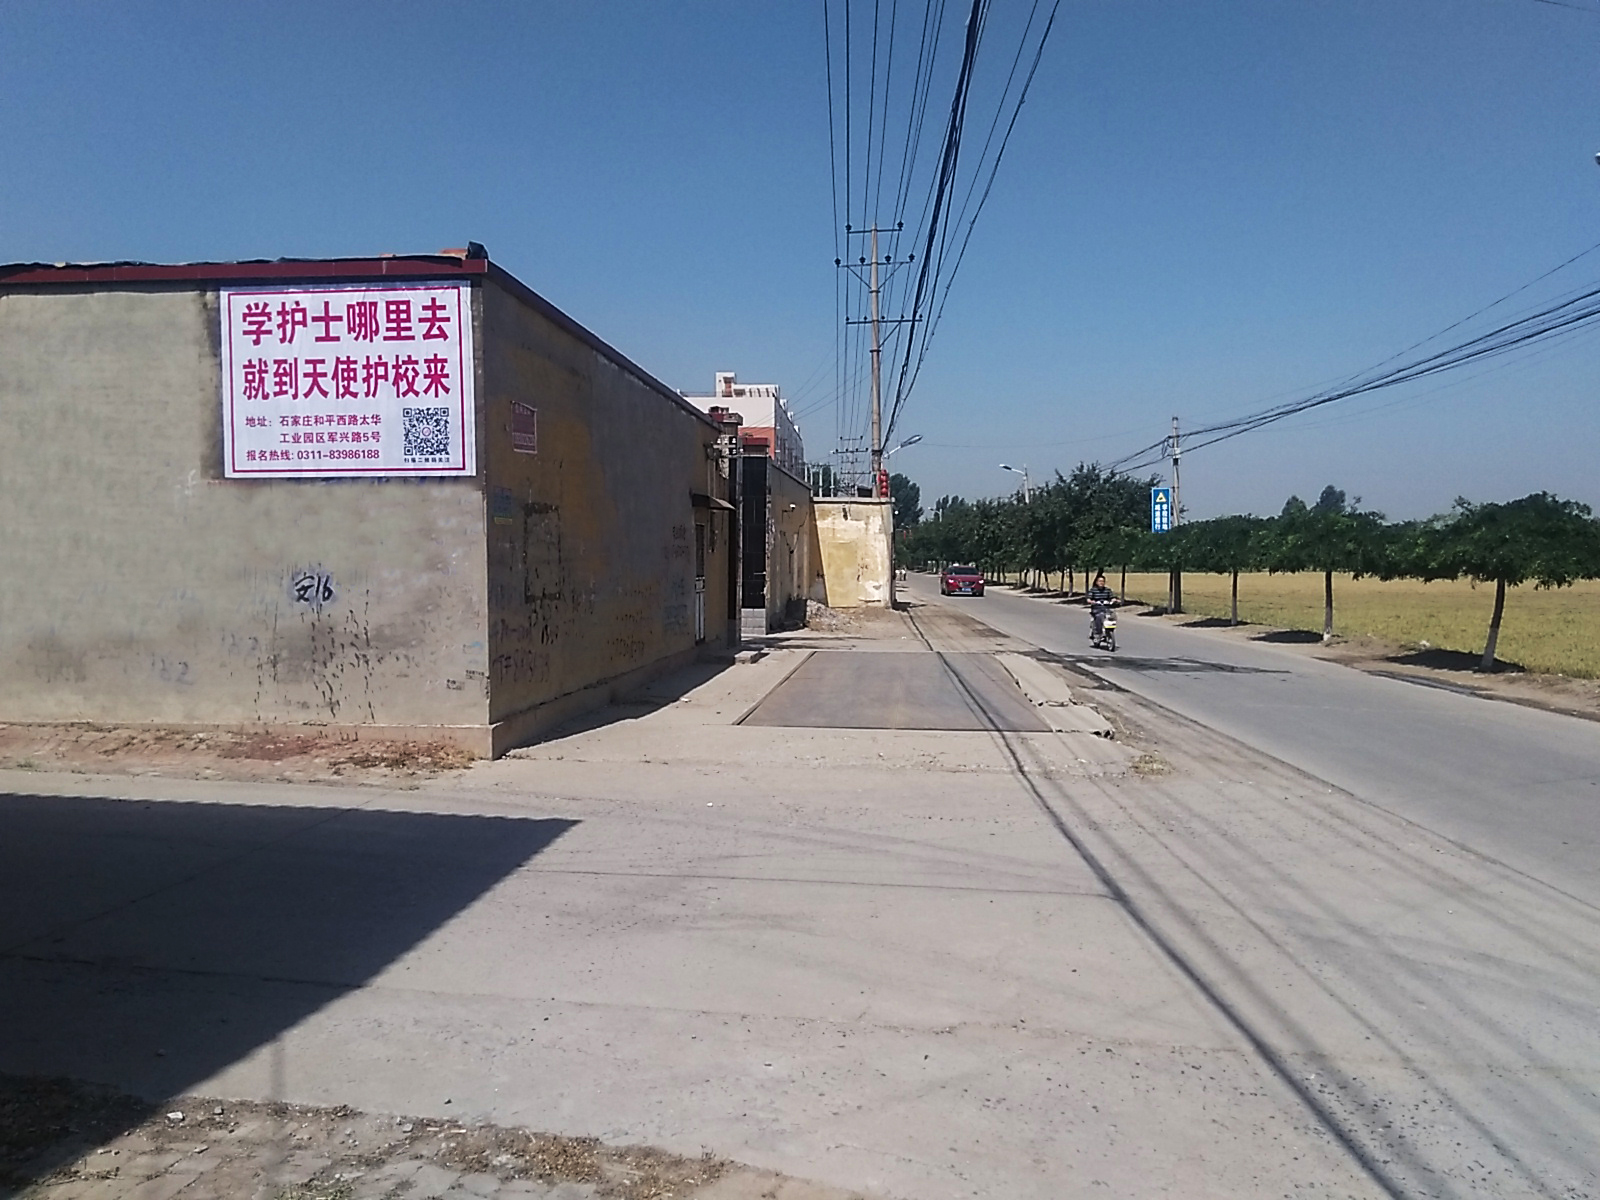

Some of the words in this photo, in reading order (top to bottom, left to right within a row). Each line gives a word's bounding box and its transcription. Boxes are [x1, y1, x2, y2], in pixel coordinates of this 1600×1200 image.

[242, 297, 451, 346] 学护士哪里去
[242, 353, 451, 401] 就到天使护校来
[279, 431, 382, 444] 工业园区军兴路5号
